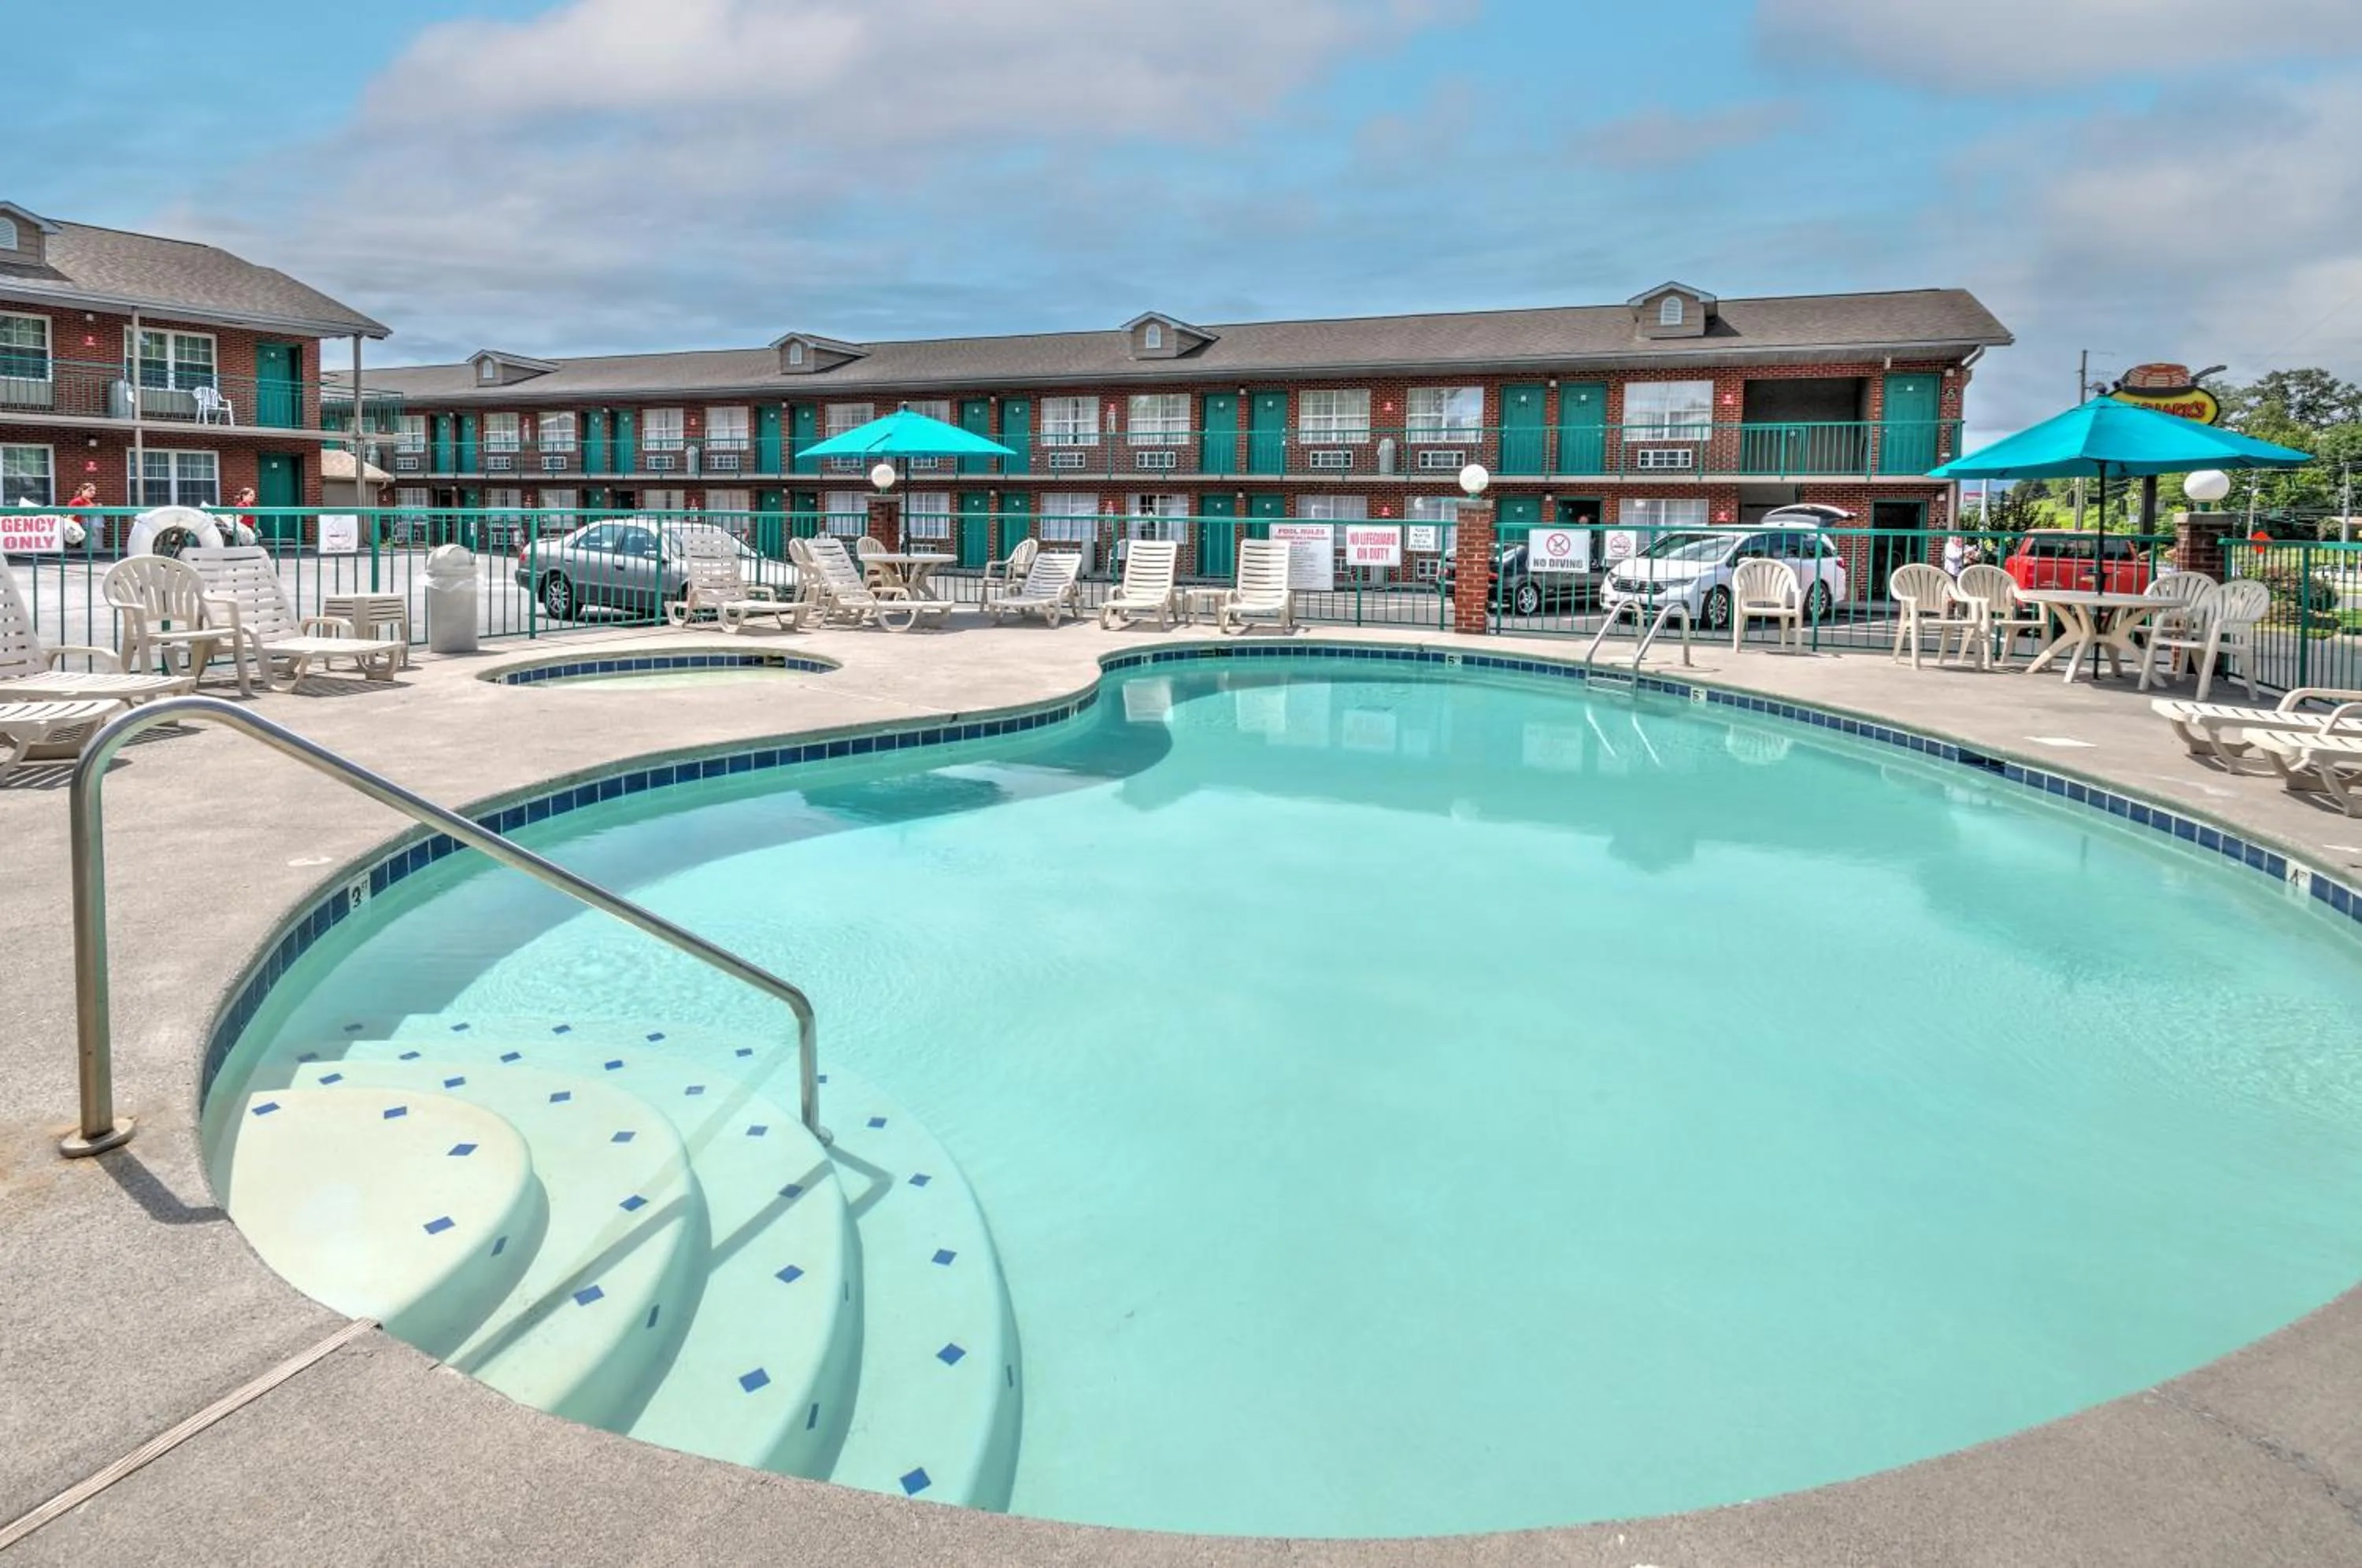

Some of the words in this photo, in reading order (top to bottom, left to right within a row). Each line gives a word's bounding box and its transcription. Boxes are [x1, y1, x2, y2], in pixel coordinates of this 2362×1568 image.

[1, 516, 56, 533] GENCY
[3, 535, 55, 549] ONLY
[1349, 532, 1359, 545] NO
[1360, 532, 1397, 545] LIFEGUARD
[1357, 547, 1368, 560] ON
[1370, 547, 1390, 560] DUTY
[1533, 558, 1546, 568] NO
[1549, 558, 1583, 568] DIVING
[352, 886, 361, 908] 3
